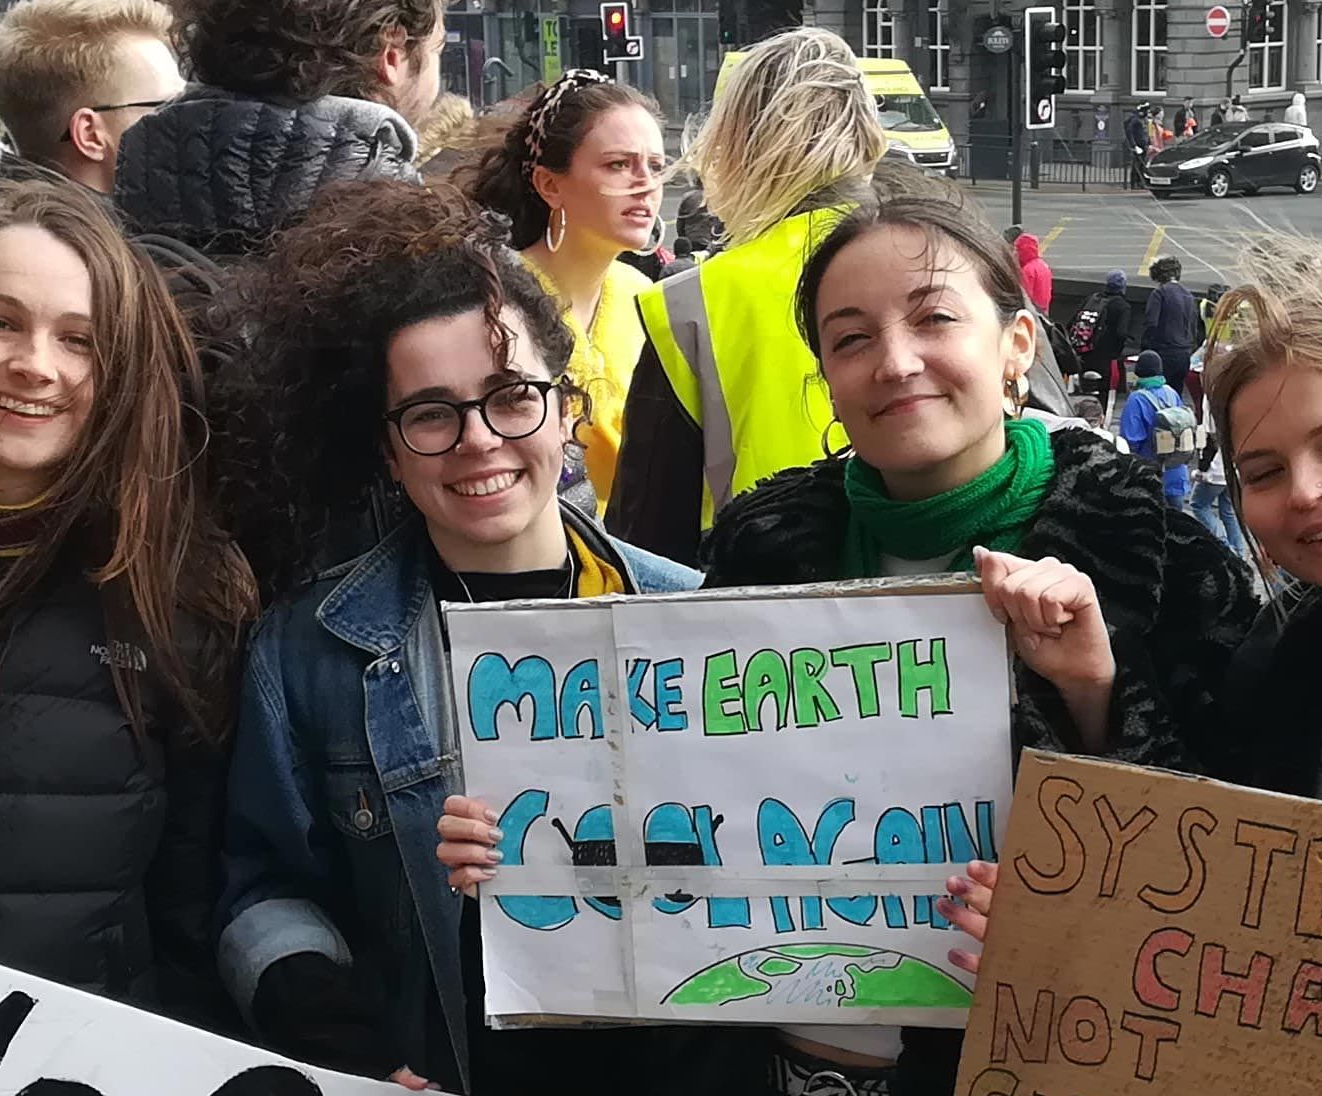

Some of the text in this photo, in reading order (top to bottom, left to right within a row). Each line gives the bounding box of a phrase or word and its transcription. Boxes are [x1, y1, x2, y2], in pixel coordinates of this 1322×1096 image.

[467, 636, 954, 742] MAKE EARTH
[756, 796, 998, 933] AGAIN
[989, 982, 1181, 1081] NOT
